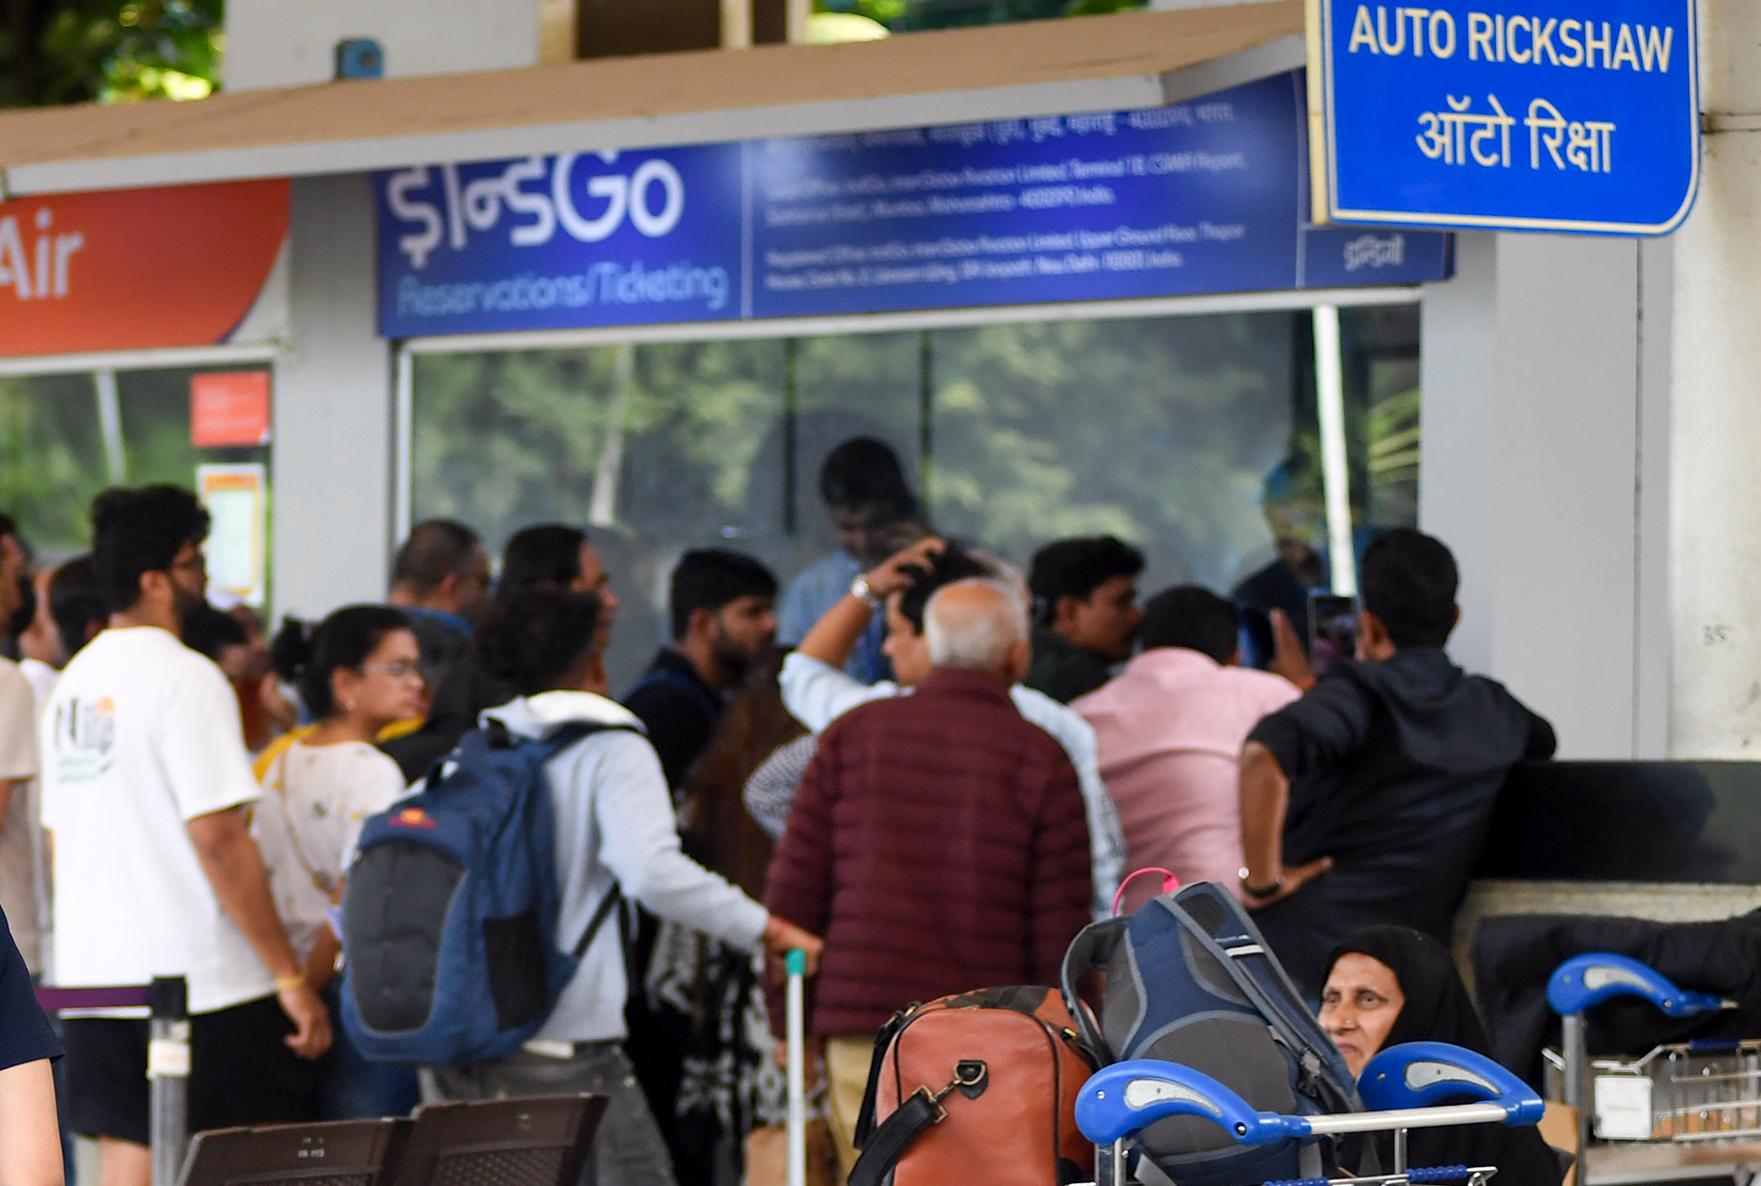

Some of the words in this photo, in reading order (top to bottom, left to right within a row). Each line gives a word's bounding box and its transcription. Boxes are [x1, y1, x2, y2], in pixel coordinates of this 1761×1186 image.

[1348, 4, 1456, 60] AUTO
[1467, 11, 1674, 73] RICKSHAW
[1414, 93, 1517, 168] ऑटो
[1523, 97, 1617, 174] रिक्षा
[397, 258, 730, 317] Reservations/Ticketing
